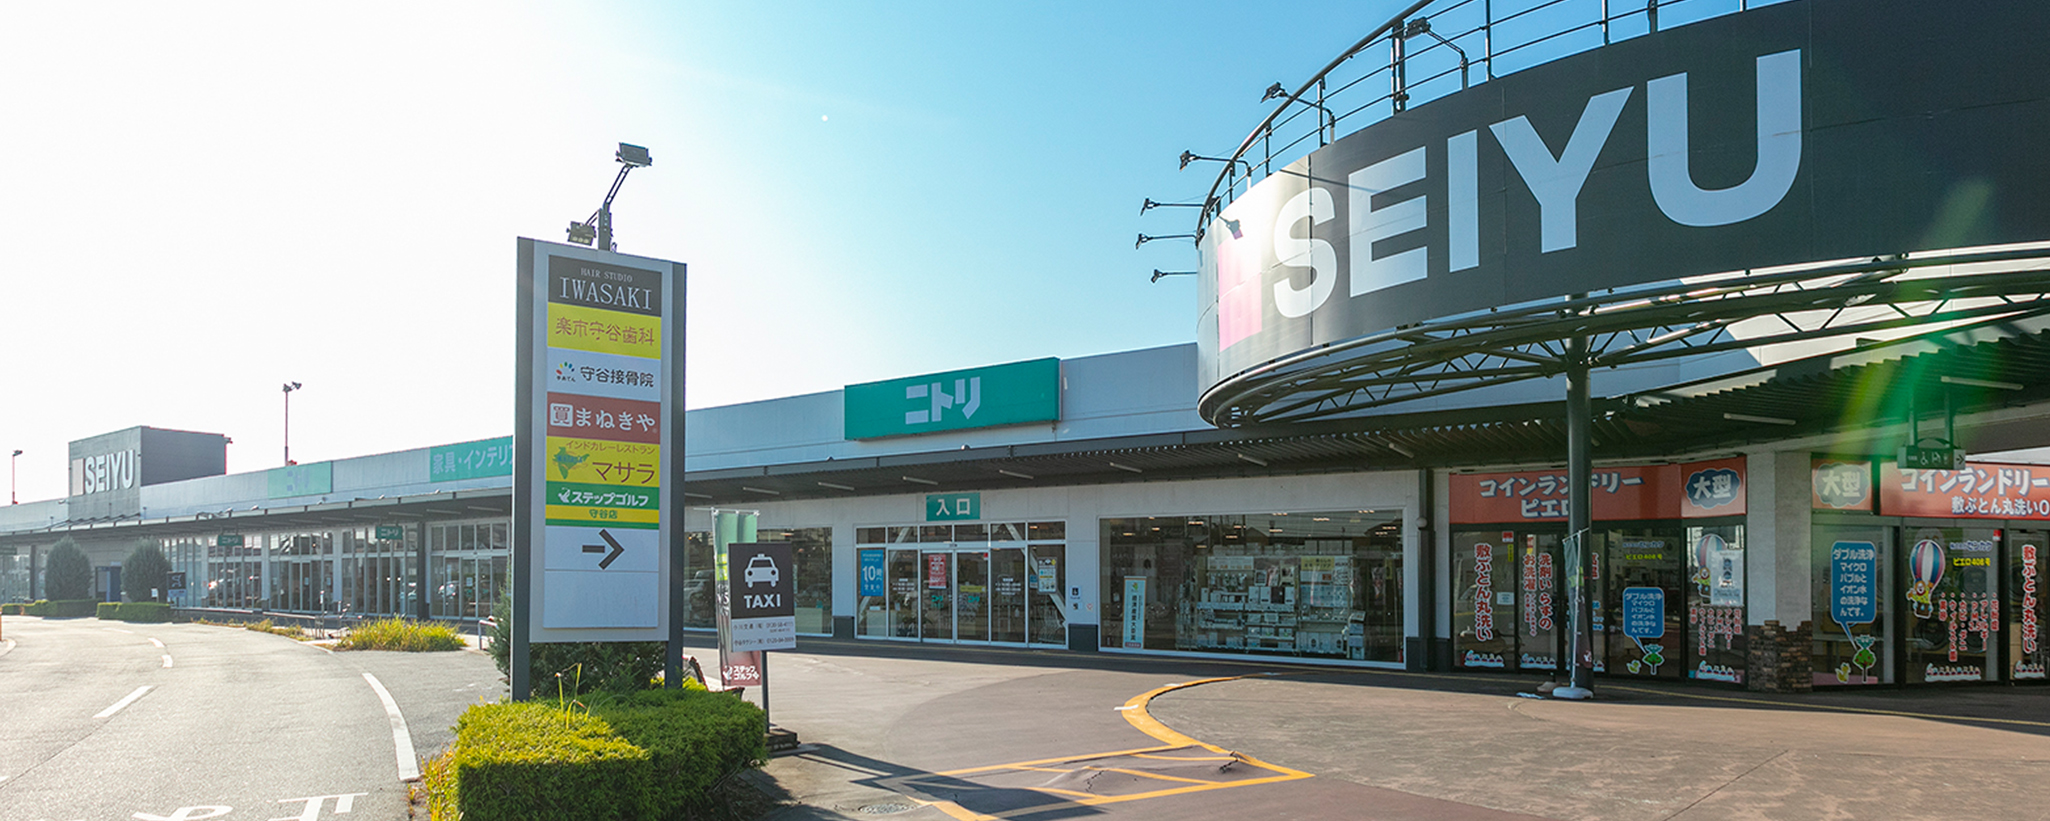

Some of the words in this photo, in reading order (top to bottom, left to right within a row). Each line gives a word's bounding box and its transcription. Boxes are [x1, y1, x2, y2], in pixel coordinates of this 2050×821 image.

[1272, 48, 1803, 319] SEIYU
[580, 267, 601, 278] HAIR
[604, 271, 633, 283] STUDIO
[559, 276, 652, 310] IWASAKI
[556, 316, 655, 346] 楽市守谷歯科
[580, 366, 654, 387] 守谷接骨院
[905, 376, 981, 425] ニトリ
[575, 408, 656, 432] まねきや
[566, 441, 655, 455] インドカレーレストラン
[84, 449, 136, 495] SEIYU
[592, 461, 655, 485] マサラ
[1900, 467, 2050, 497] コインランドリー
[1694, 474, 1733, 500] 大型
[1822, 471, 1861, 497] 大型
[571, 490, 649, 507] ステップゴルフ
[935, 498, 971, 517] 入口
[1521, 498, 1568, 518] ピエ
[589, 508, 618, 519] 守谷店
[1833, 547, 1876, 561] ダブル洗浄
[1840, 562, 1867, 572] マイクロ
[1840, 573, 1867, 583] バブルと
[1625, 593, 1663, 601] ダブル洗浄
[1840, 585, 1867, 595] イオン水
[743, 594, 781, 608] TAXI
